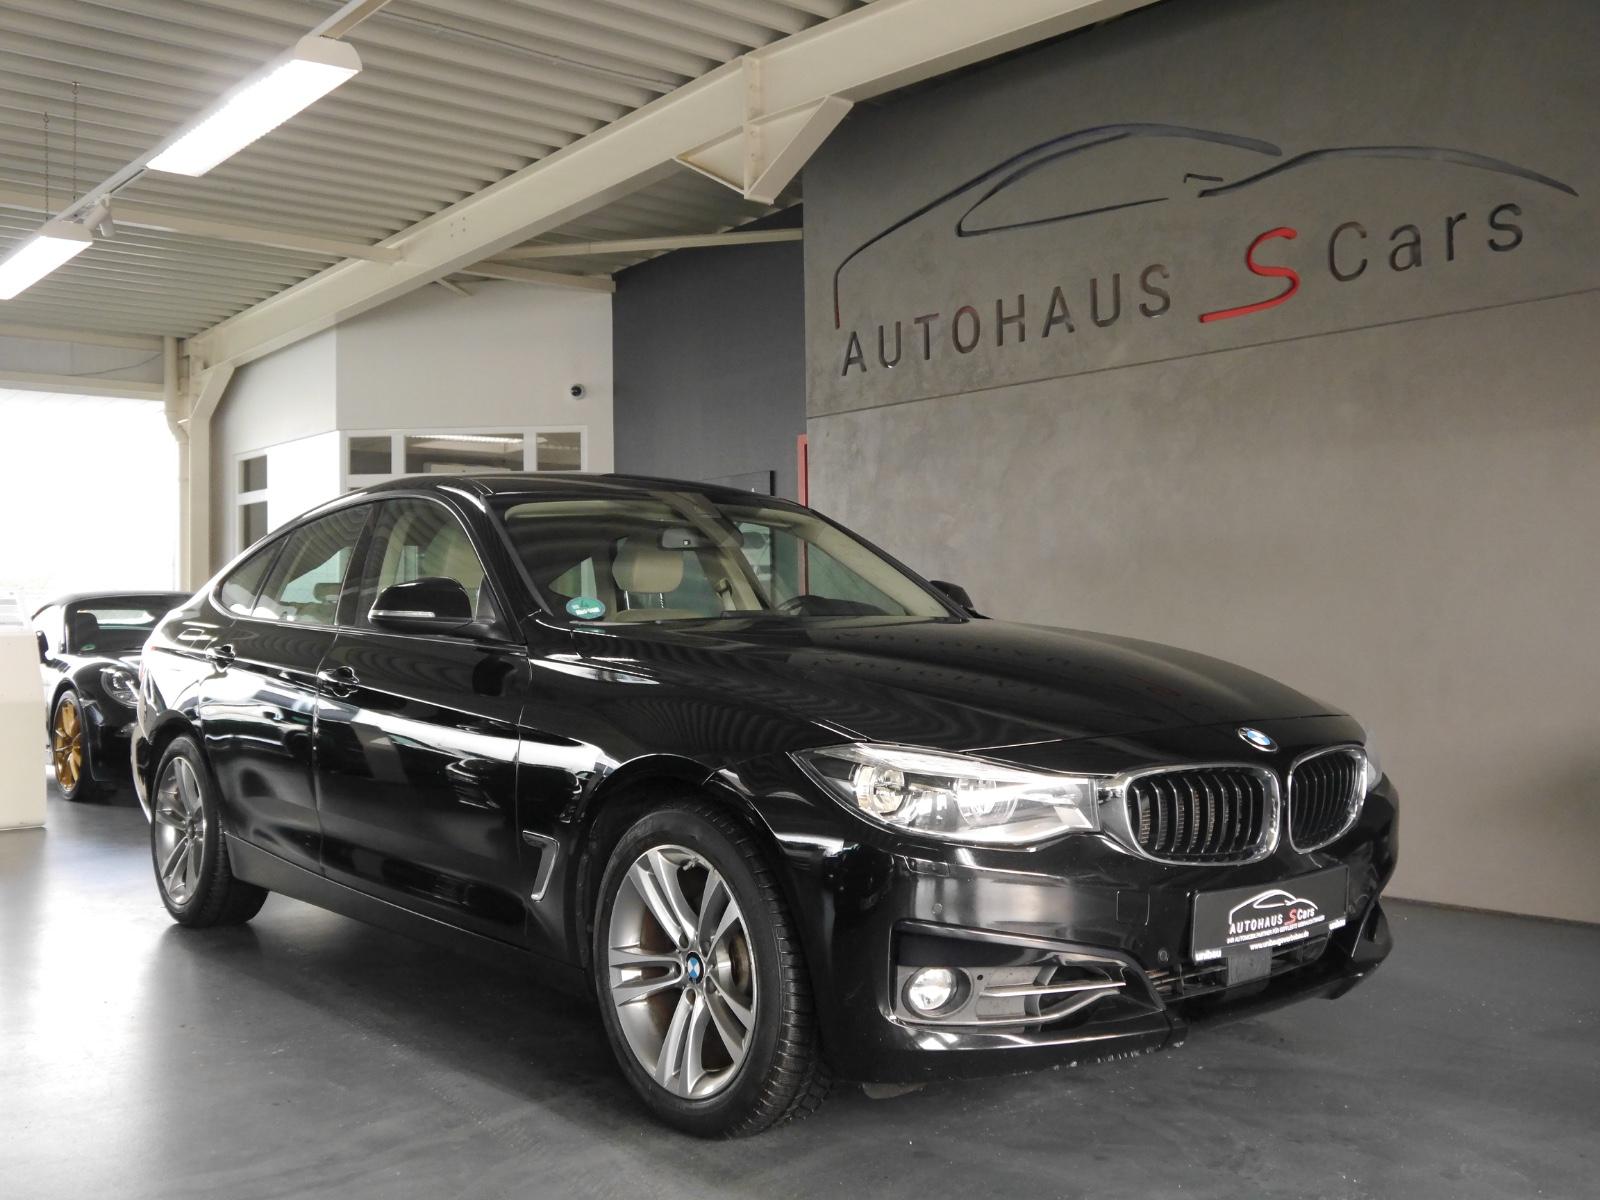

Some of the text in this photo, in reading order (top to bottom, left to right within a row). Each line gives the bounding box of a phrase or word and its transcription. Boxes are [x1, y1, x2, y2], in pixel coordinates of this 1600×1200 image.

[841, 203, 1525, 377] AUTOHAUS S Cars
[1228, 913, 1283, 935] AUTOHAUS
[1284, 908, 1297, 926] S
[1296, 907, 1315, 920] Cars
[1195, 949, 1222, 961] unibau
